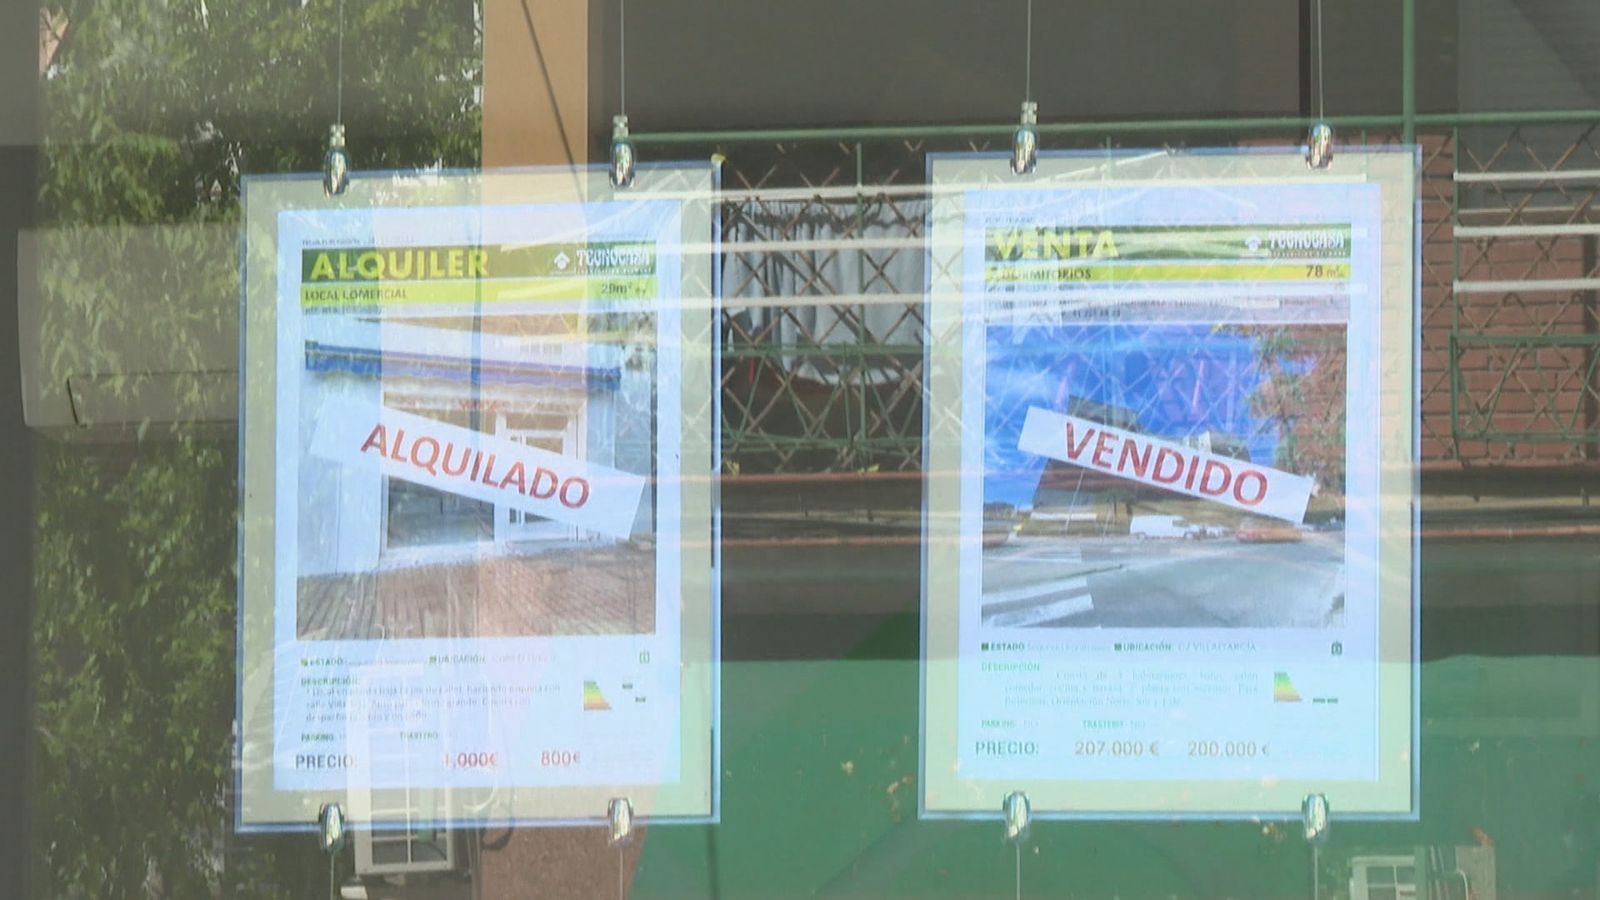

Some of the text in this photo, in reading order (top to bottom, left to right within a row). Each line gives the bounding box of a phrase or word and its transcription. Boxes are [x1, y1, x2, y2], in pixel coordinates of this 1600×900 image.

[993, 230, 1120, 259] VENTA
[1268, 230, 1345, 249] TECNOCASA
[310, 247, 491, 281] ALQUILER
[1305, 264, 1324, 278] 78
[304, 287, 407, 302] LOCAL COMERCIAL
[360, 423, 591, 510] ALQUILADO
[1065, 421, 1268, 506] VENDIDO
[975, 740, 1040, 757] PRECIO:
